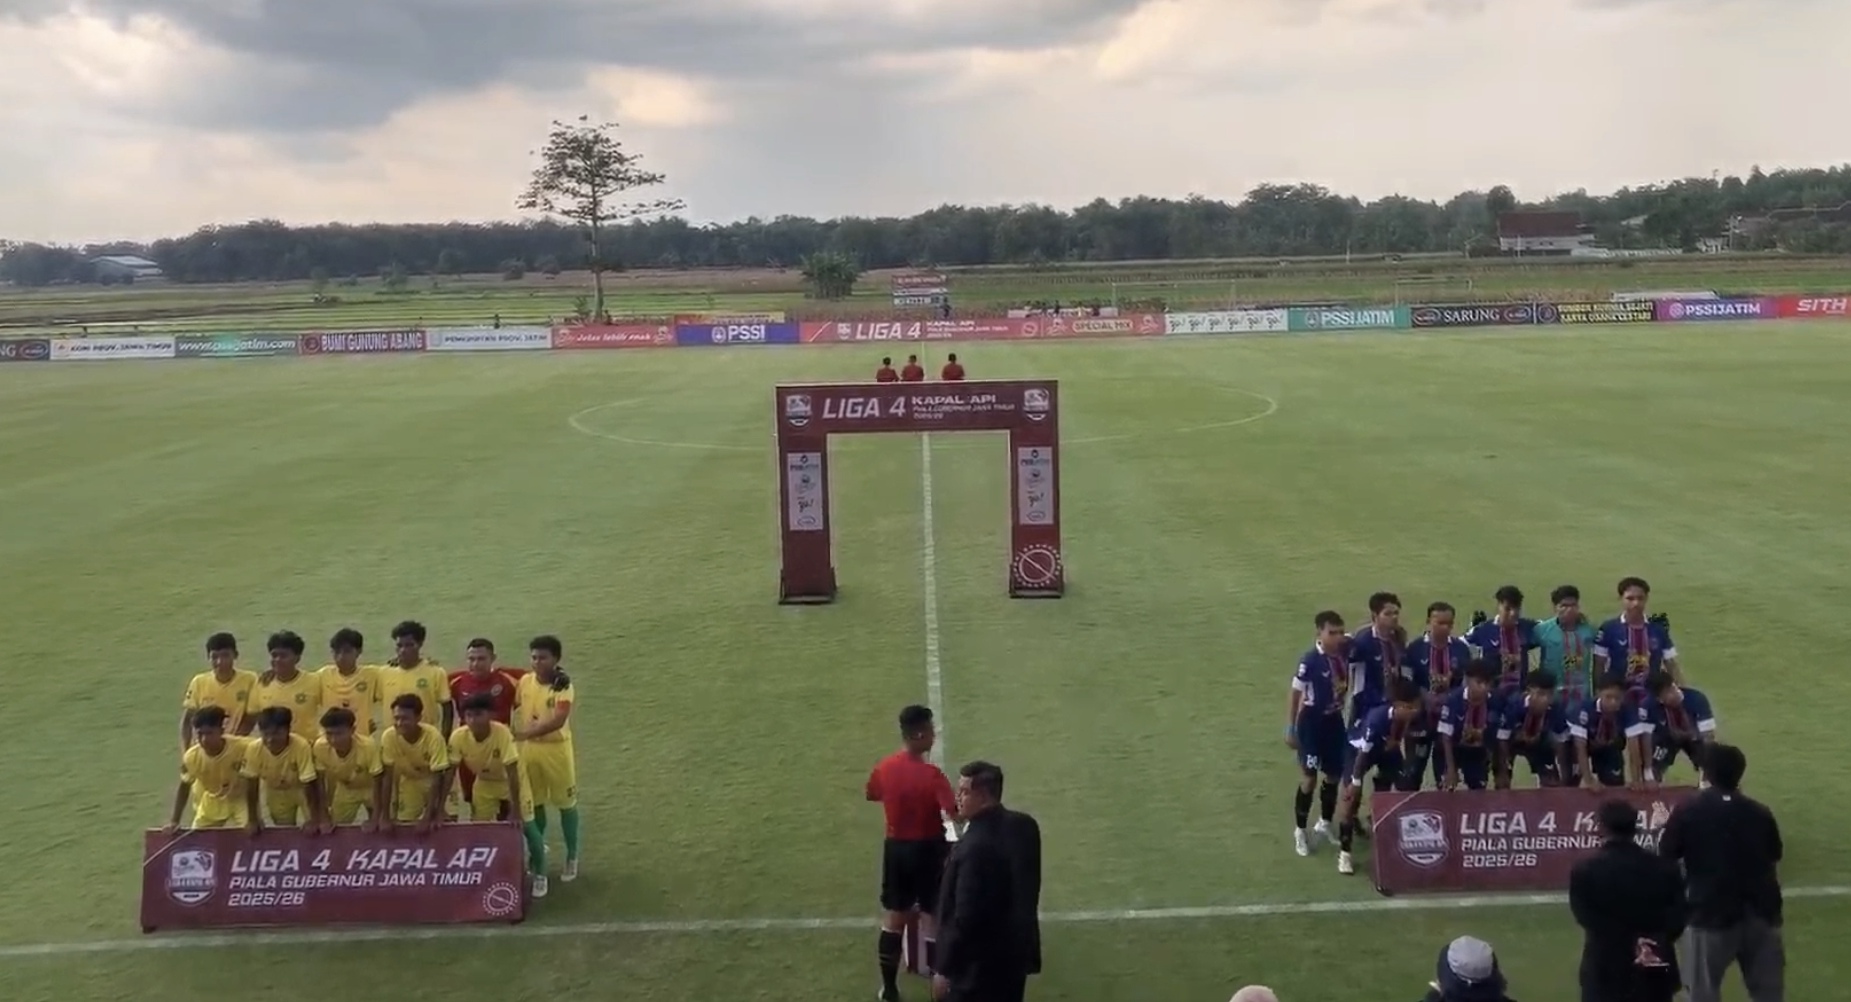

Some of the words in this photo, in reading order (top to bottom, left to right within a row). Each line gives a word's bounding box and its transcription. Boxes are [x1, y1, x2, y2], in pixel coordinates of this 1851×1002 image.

[1444, 308, 1500, 322] SARUNG
[728, 325, 766, 340] PSSI
[855, 323, 900, 339] LIGA
[907, 322, 921, 338] 4
[1075, 321, 1114, 330] SPECIAL
[1115, 320, 1131, 329] MIX
[322, 335, 345, 351] BUMI
[347, 333, 388, 350] GUNUNG
[390, 332, 423, 348] ABANG
[912, 395, 964, 405] KAPAL
[970, 394, 996, 403] API
[822, 398, 880, 419] LIGA
[889, 397, 906, 417] 4
[1460, 812, 1527, 834] LIGA
[1538, 811, 1557, 832] 4
[1461, 837, 1507, 851] PIALA
[230, 849, 299, 873] LIGA
[311, 849, 331, 871] 4
[346, 848, 438, 870] KAPAL
[446, 847, 498, 868] API
[1463, 854, 1537, 868] 2025/26
[229, 875, 276, 889] PIALA
[281, 874, 374, 888] GUBERNUR
[378, 874, 425, 886] JAWA
[432, 872, 482, 885] TIMUR
[228, 892, 305, 906] 2025/26
